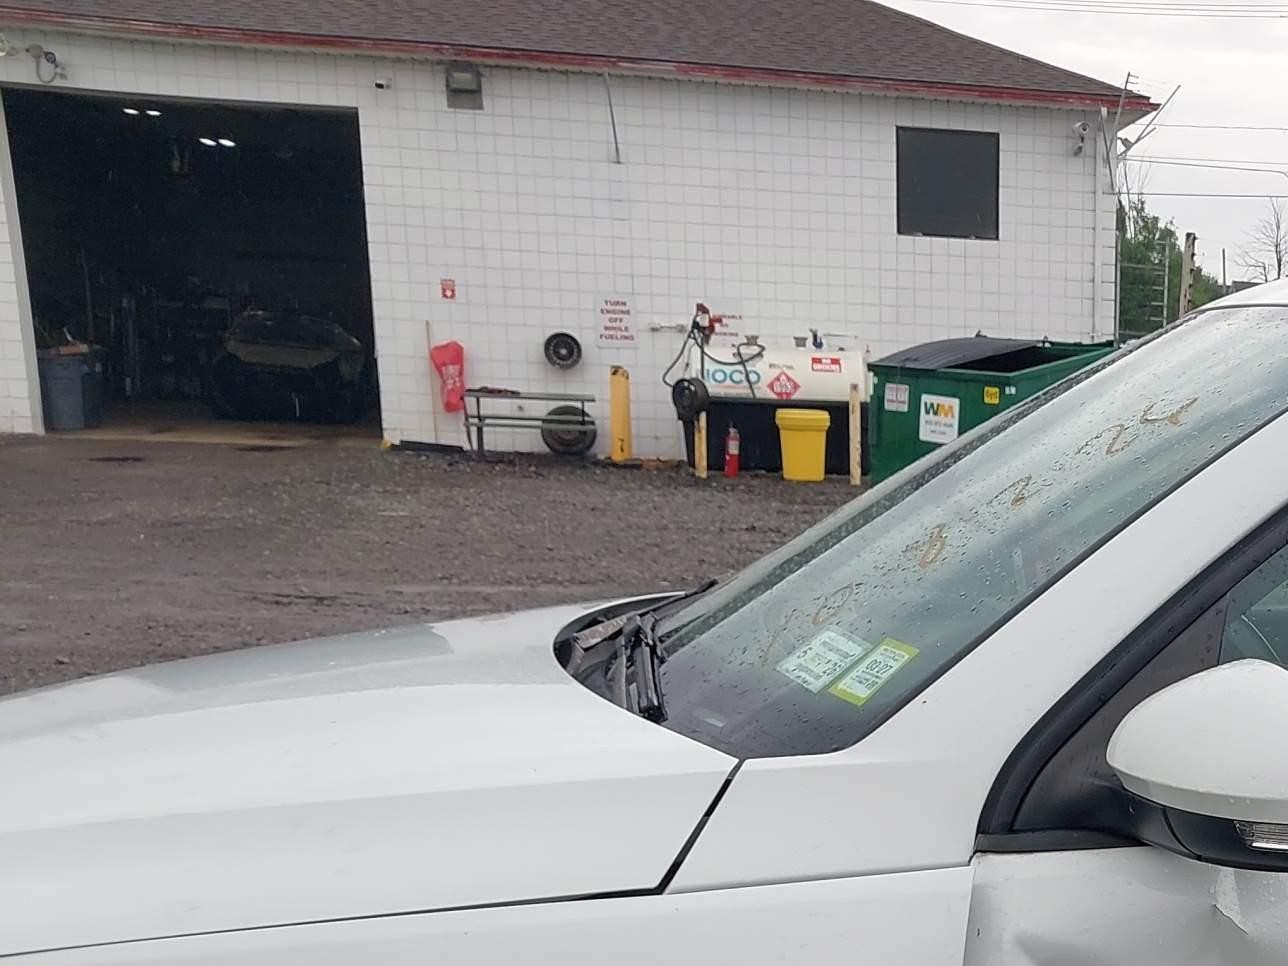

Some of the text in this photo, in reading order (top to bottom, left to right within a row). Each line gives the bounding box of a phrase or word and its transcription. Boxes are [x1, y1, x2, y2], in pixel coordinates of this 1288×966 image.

[604, 299, 627, 307] TURN
[600, 308, 631, 316] ENGINE
[608, 316, 624, 324] OFF
[603, 325, 629, 333] WHILE
[600, 334, 635, 342] FUELING
[923, 401, 955, 419] WM
